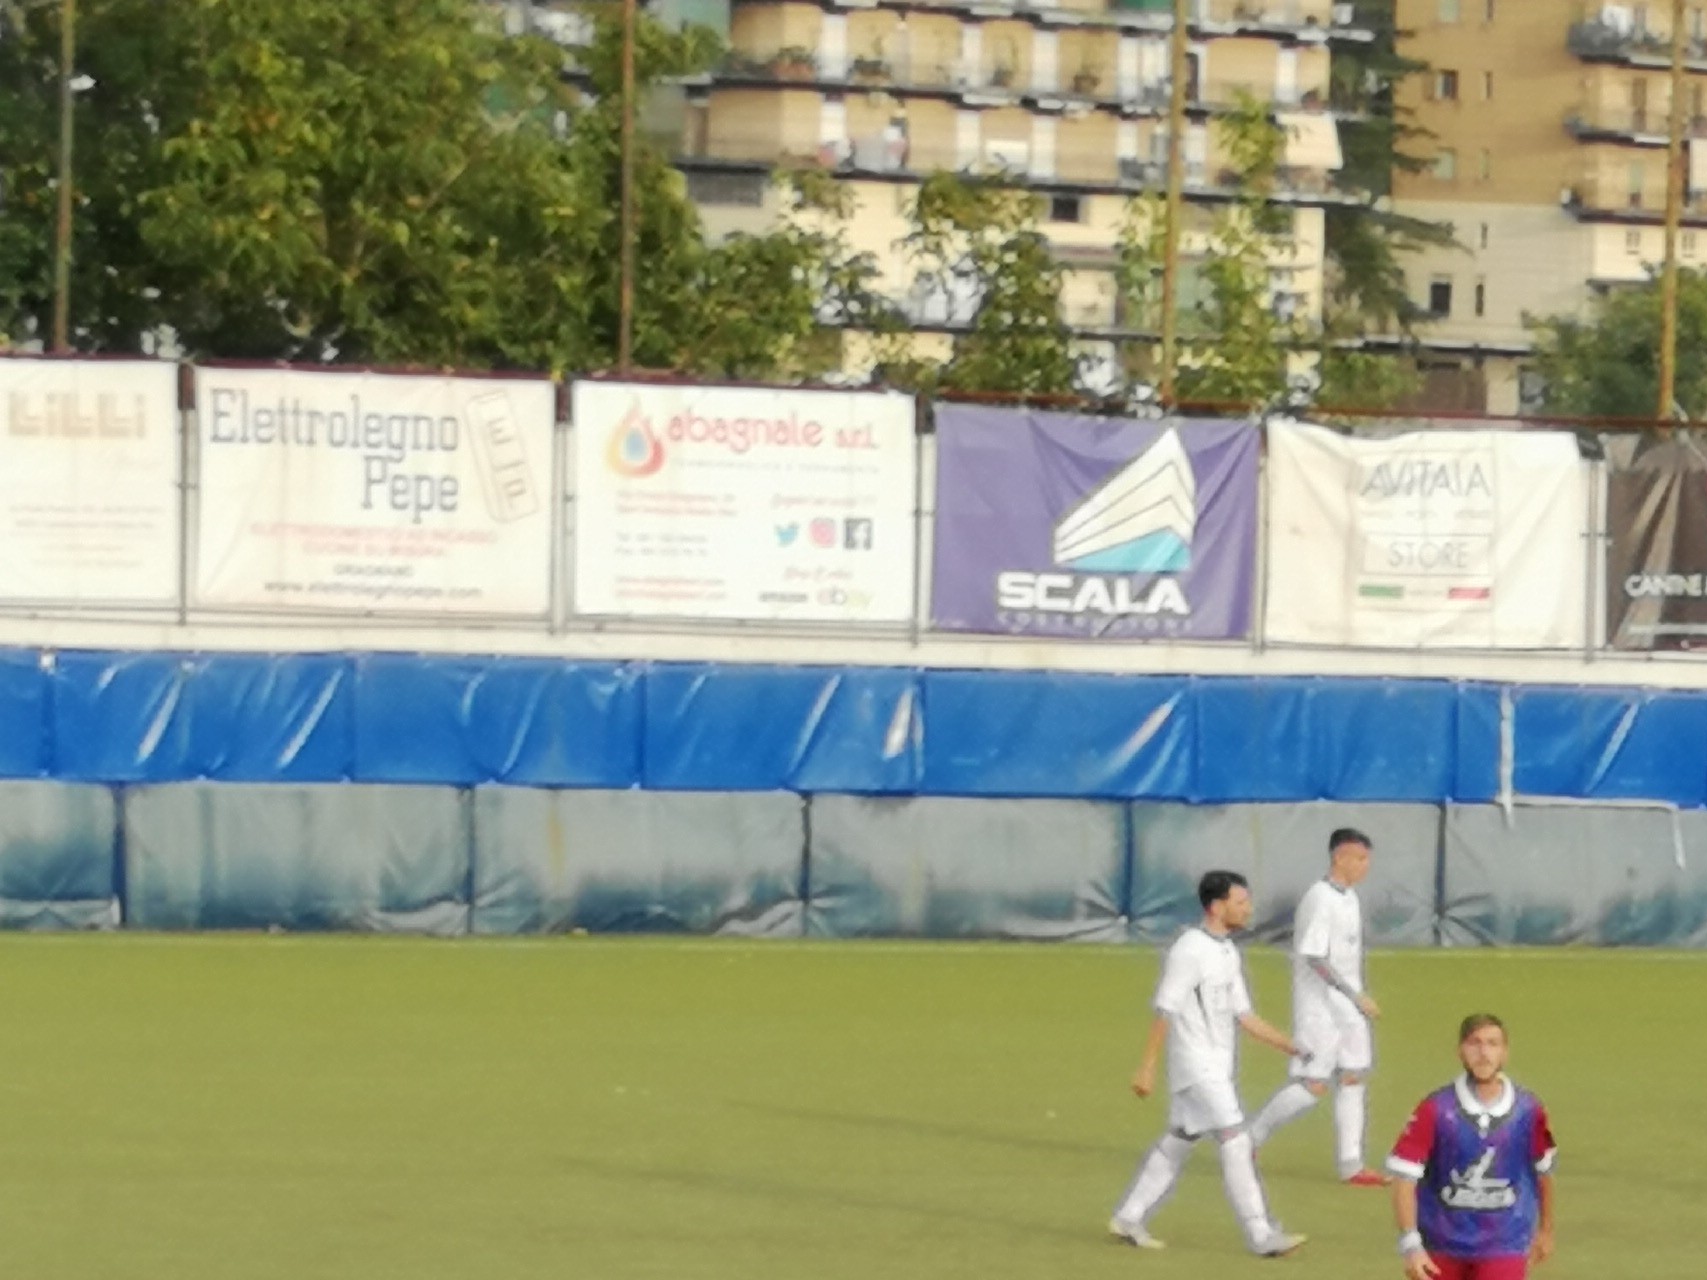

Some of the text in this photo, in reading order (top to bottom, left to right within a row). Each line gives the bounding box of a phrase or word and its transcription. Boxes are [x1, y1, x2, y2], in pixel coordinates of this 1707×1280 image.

[210, 387, 459, 460] Elettrolegno
[666, 407, 822, 455] abagnale
[361, 454, 459, 525] Pepe
[998, 570, 1192, 616] SCALA
